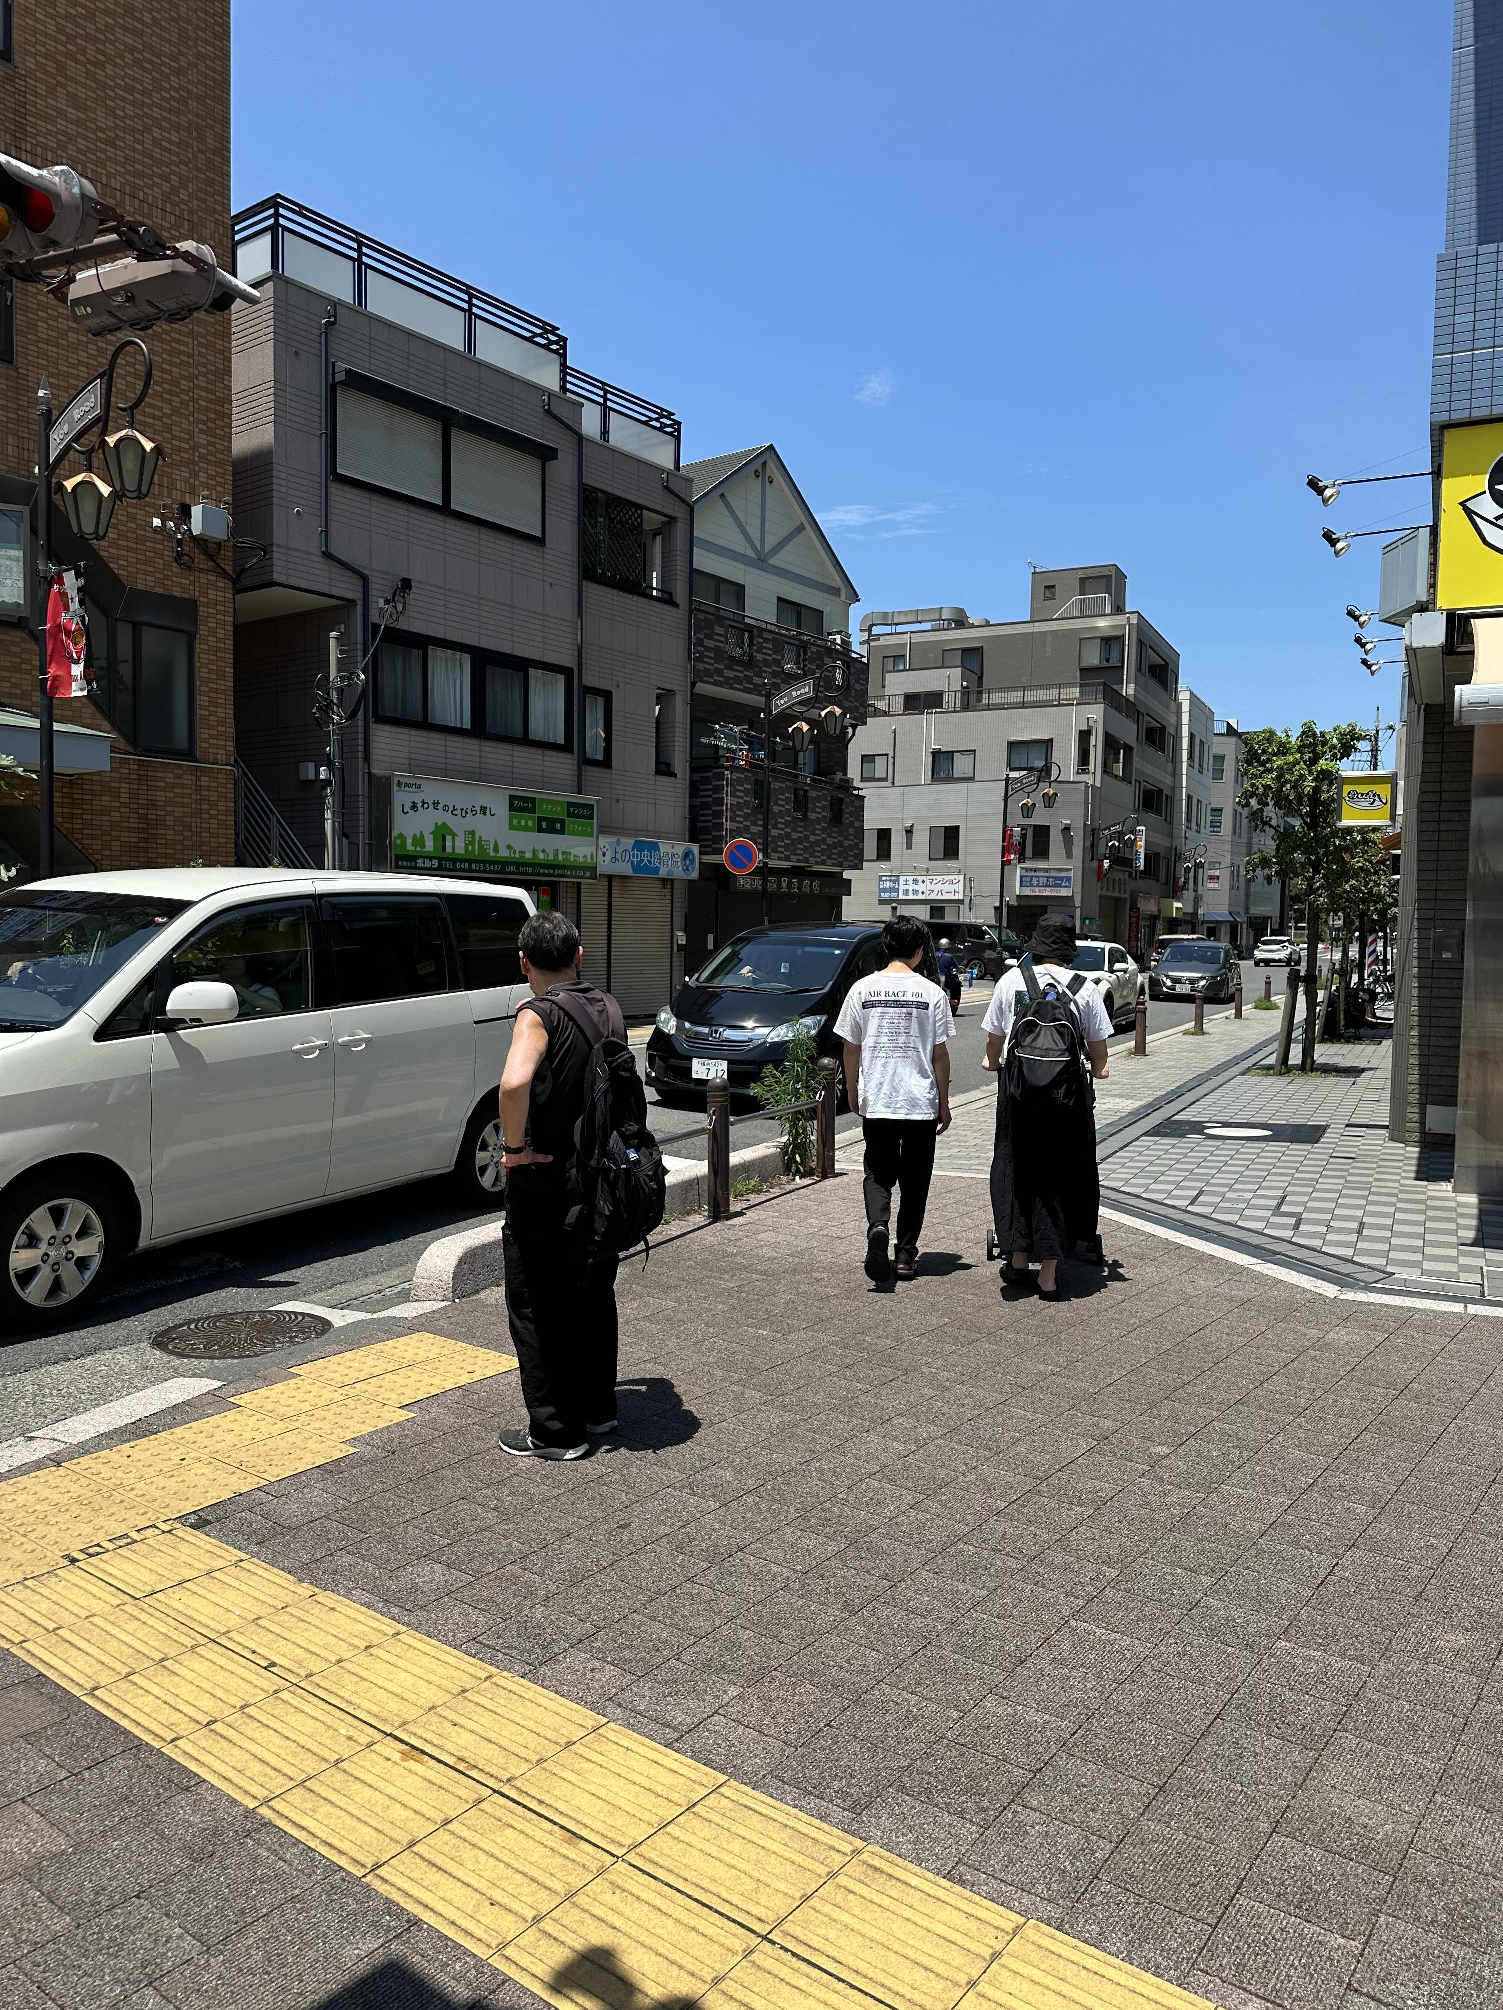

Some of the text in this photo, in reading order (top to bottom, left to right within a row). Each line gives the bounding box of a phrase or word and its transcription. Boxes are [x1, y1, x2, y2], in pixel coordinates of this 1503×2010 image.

[52, 394, 95, 444] You Road
[776, 686, 809, 706] You Road
[401, 799, 496, 818] しあわせのとびら探し
[569, 807, 592, 815] マンション
[569, 824, 592, 832] リフォーム
[610, 847, 681, 869] よの中央接骨院
[416, 858, 439, 868] ポルタ
[902, 877, 920, 886] 土地
[927, 877, 961, 885] マンション
[927, 888, 960, 897] アパート
[868, 990, 924, 999] AIR RACE 101
